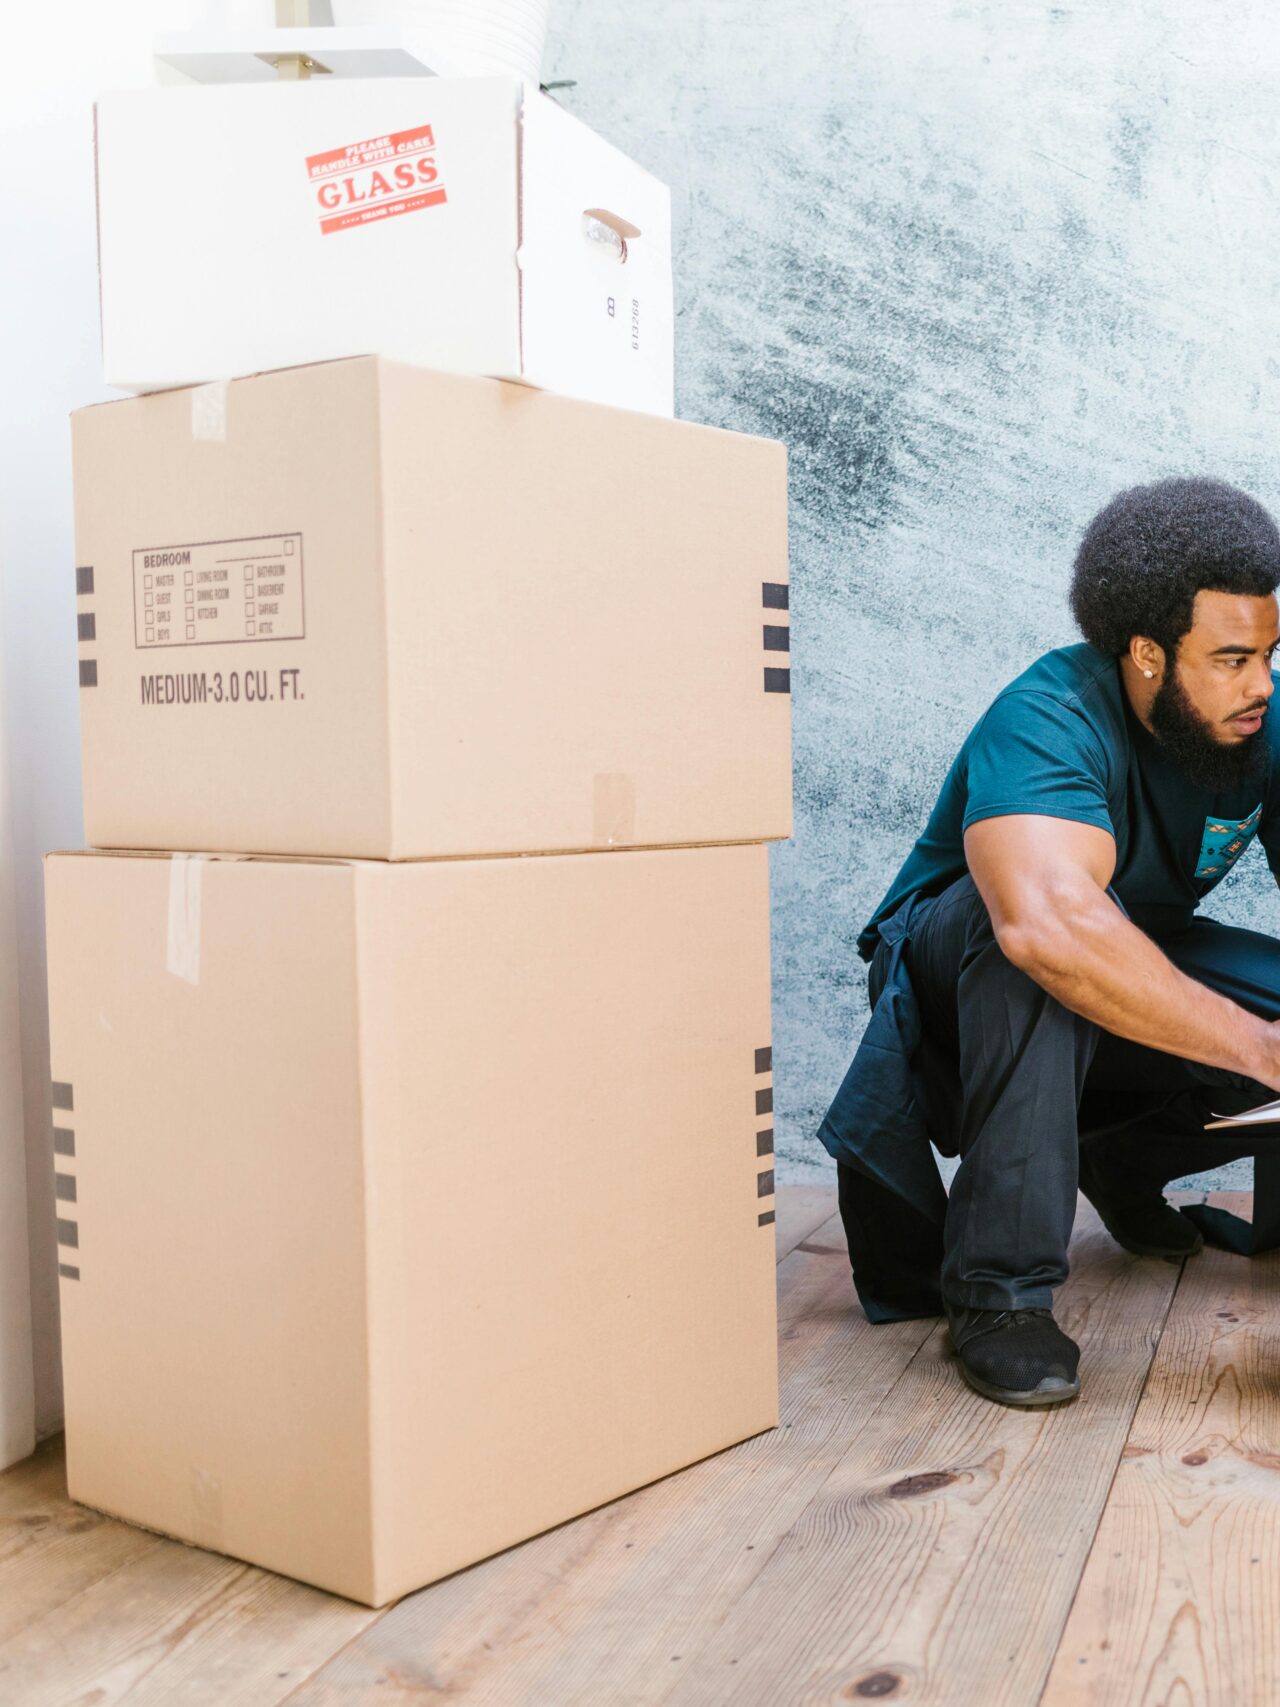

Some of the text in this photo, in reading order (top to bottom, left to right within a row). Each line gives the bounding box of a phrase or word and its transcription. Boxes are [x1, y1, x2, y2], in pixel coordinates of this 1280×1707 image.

[311, 136, 430, 176] HANDLE WITH CARE
[345, 136, 391, 157] PLEASE
[317, 157, 438, 209] GLASS
[144, 551, 191, 568] BEDROOM
[141, 669, 305, 705] MEDIUM-3.0 CU. FT.
